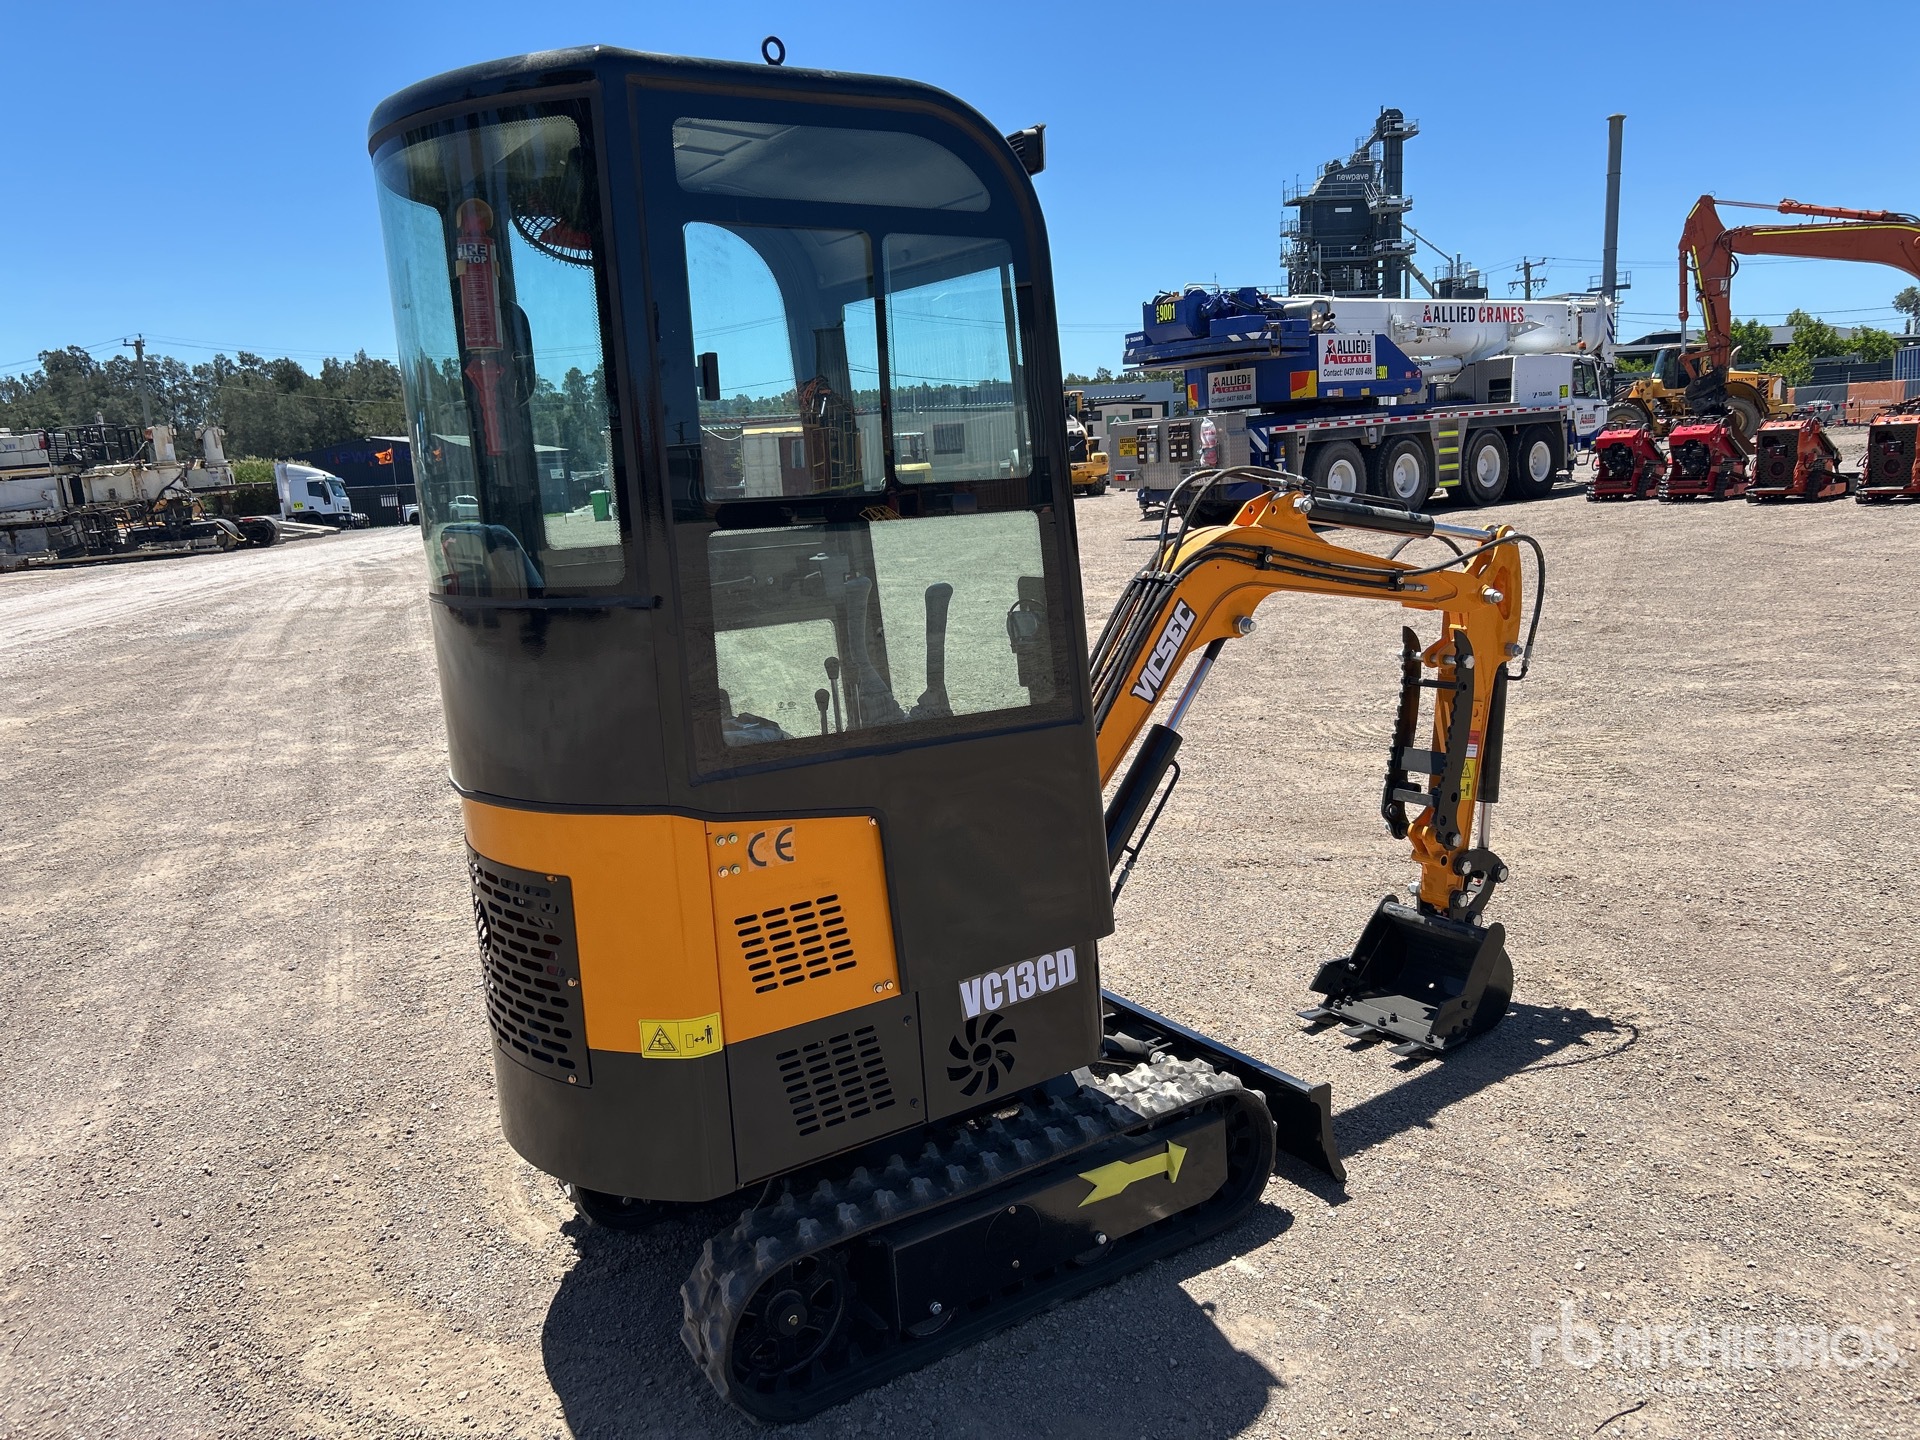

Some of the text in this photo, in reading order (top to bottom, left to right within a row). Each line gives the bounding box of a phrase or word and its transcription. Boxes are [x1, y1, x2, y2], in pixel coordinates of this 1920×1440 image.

[1336, 173, 1369, 182] newpave
[1159, 303, 1176, 321] 9001
[1433, 305, 1476, 323] ALLIED
[1478, 305, 1524, 323] CRANES
[1337, 340, 1367, 354] ALLIED
[1341, 355, 1368, 363] CRANE
[1221, 374, 1247, 387] ALLIED
[1132, 600, 1196, 702] VICSEC
[747, 827, 795, 867] CE
[959, 948, 1077, 1019] VC13CD
